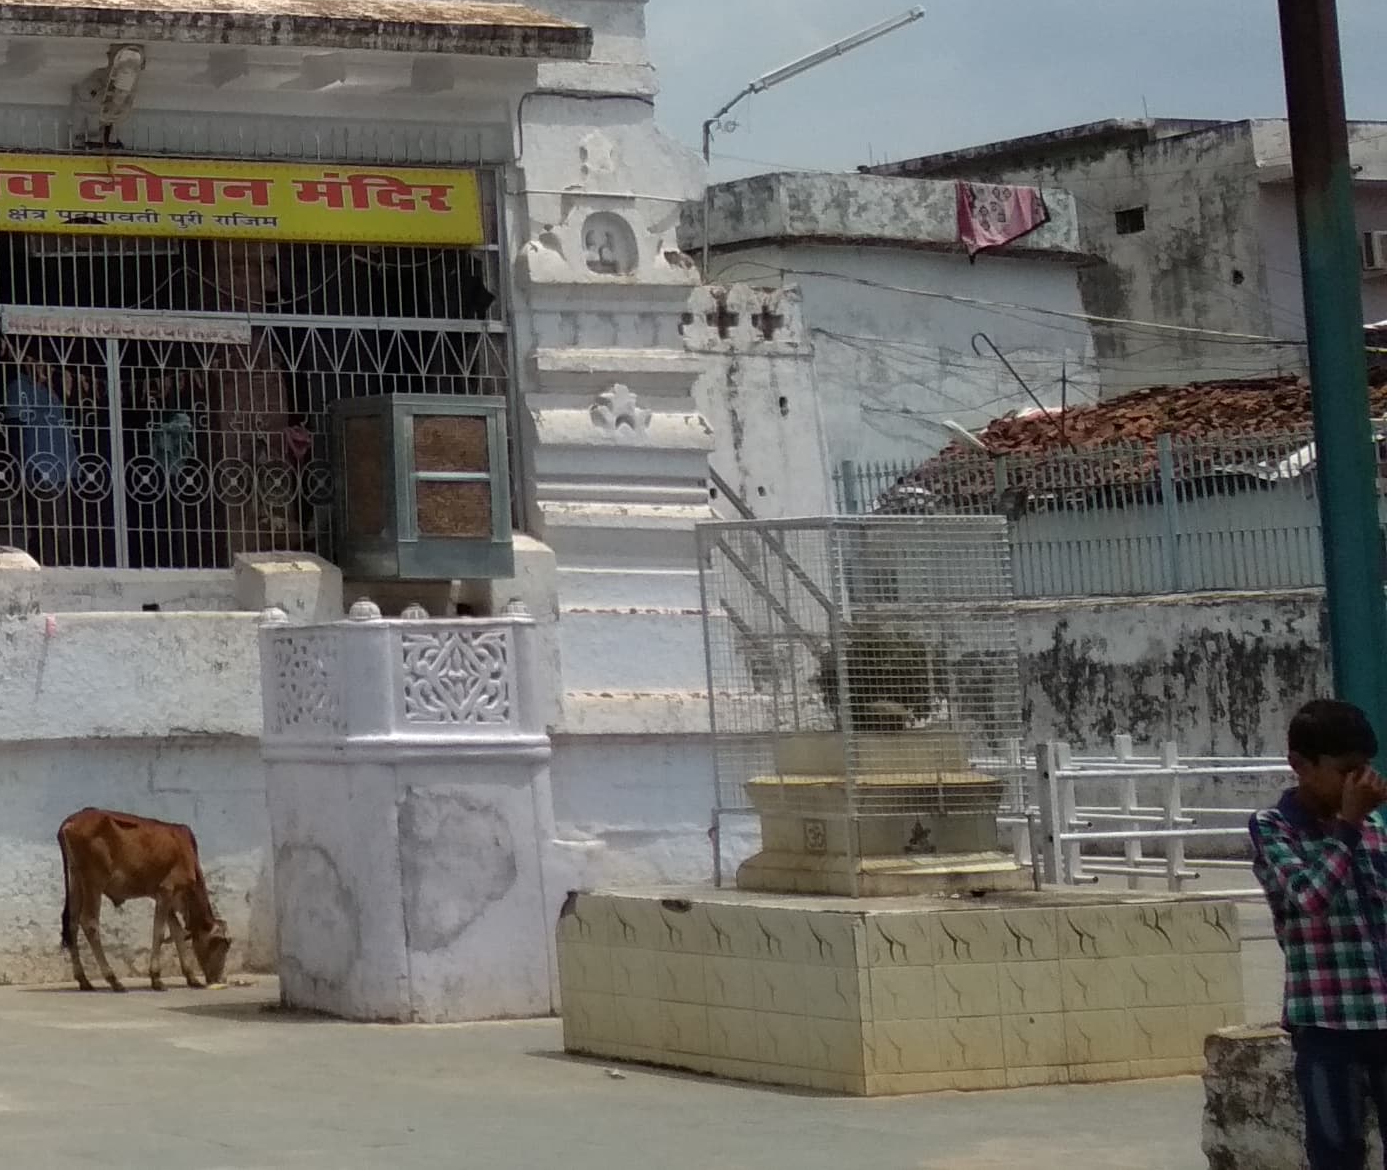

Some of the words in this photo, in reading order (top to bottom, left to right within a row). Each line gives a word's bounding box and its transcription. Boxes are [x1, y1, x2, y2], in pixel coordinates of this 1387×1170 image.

[74, 164, 274, 207] लोचन
[291, 172, 453, 212] मंदिर
[7, 205, 48, 220] क्षेत्र
[169, 212, 204, 229] पुरी
[213, 212, 277, 227] राजिम
